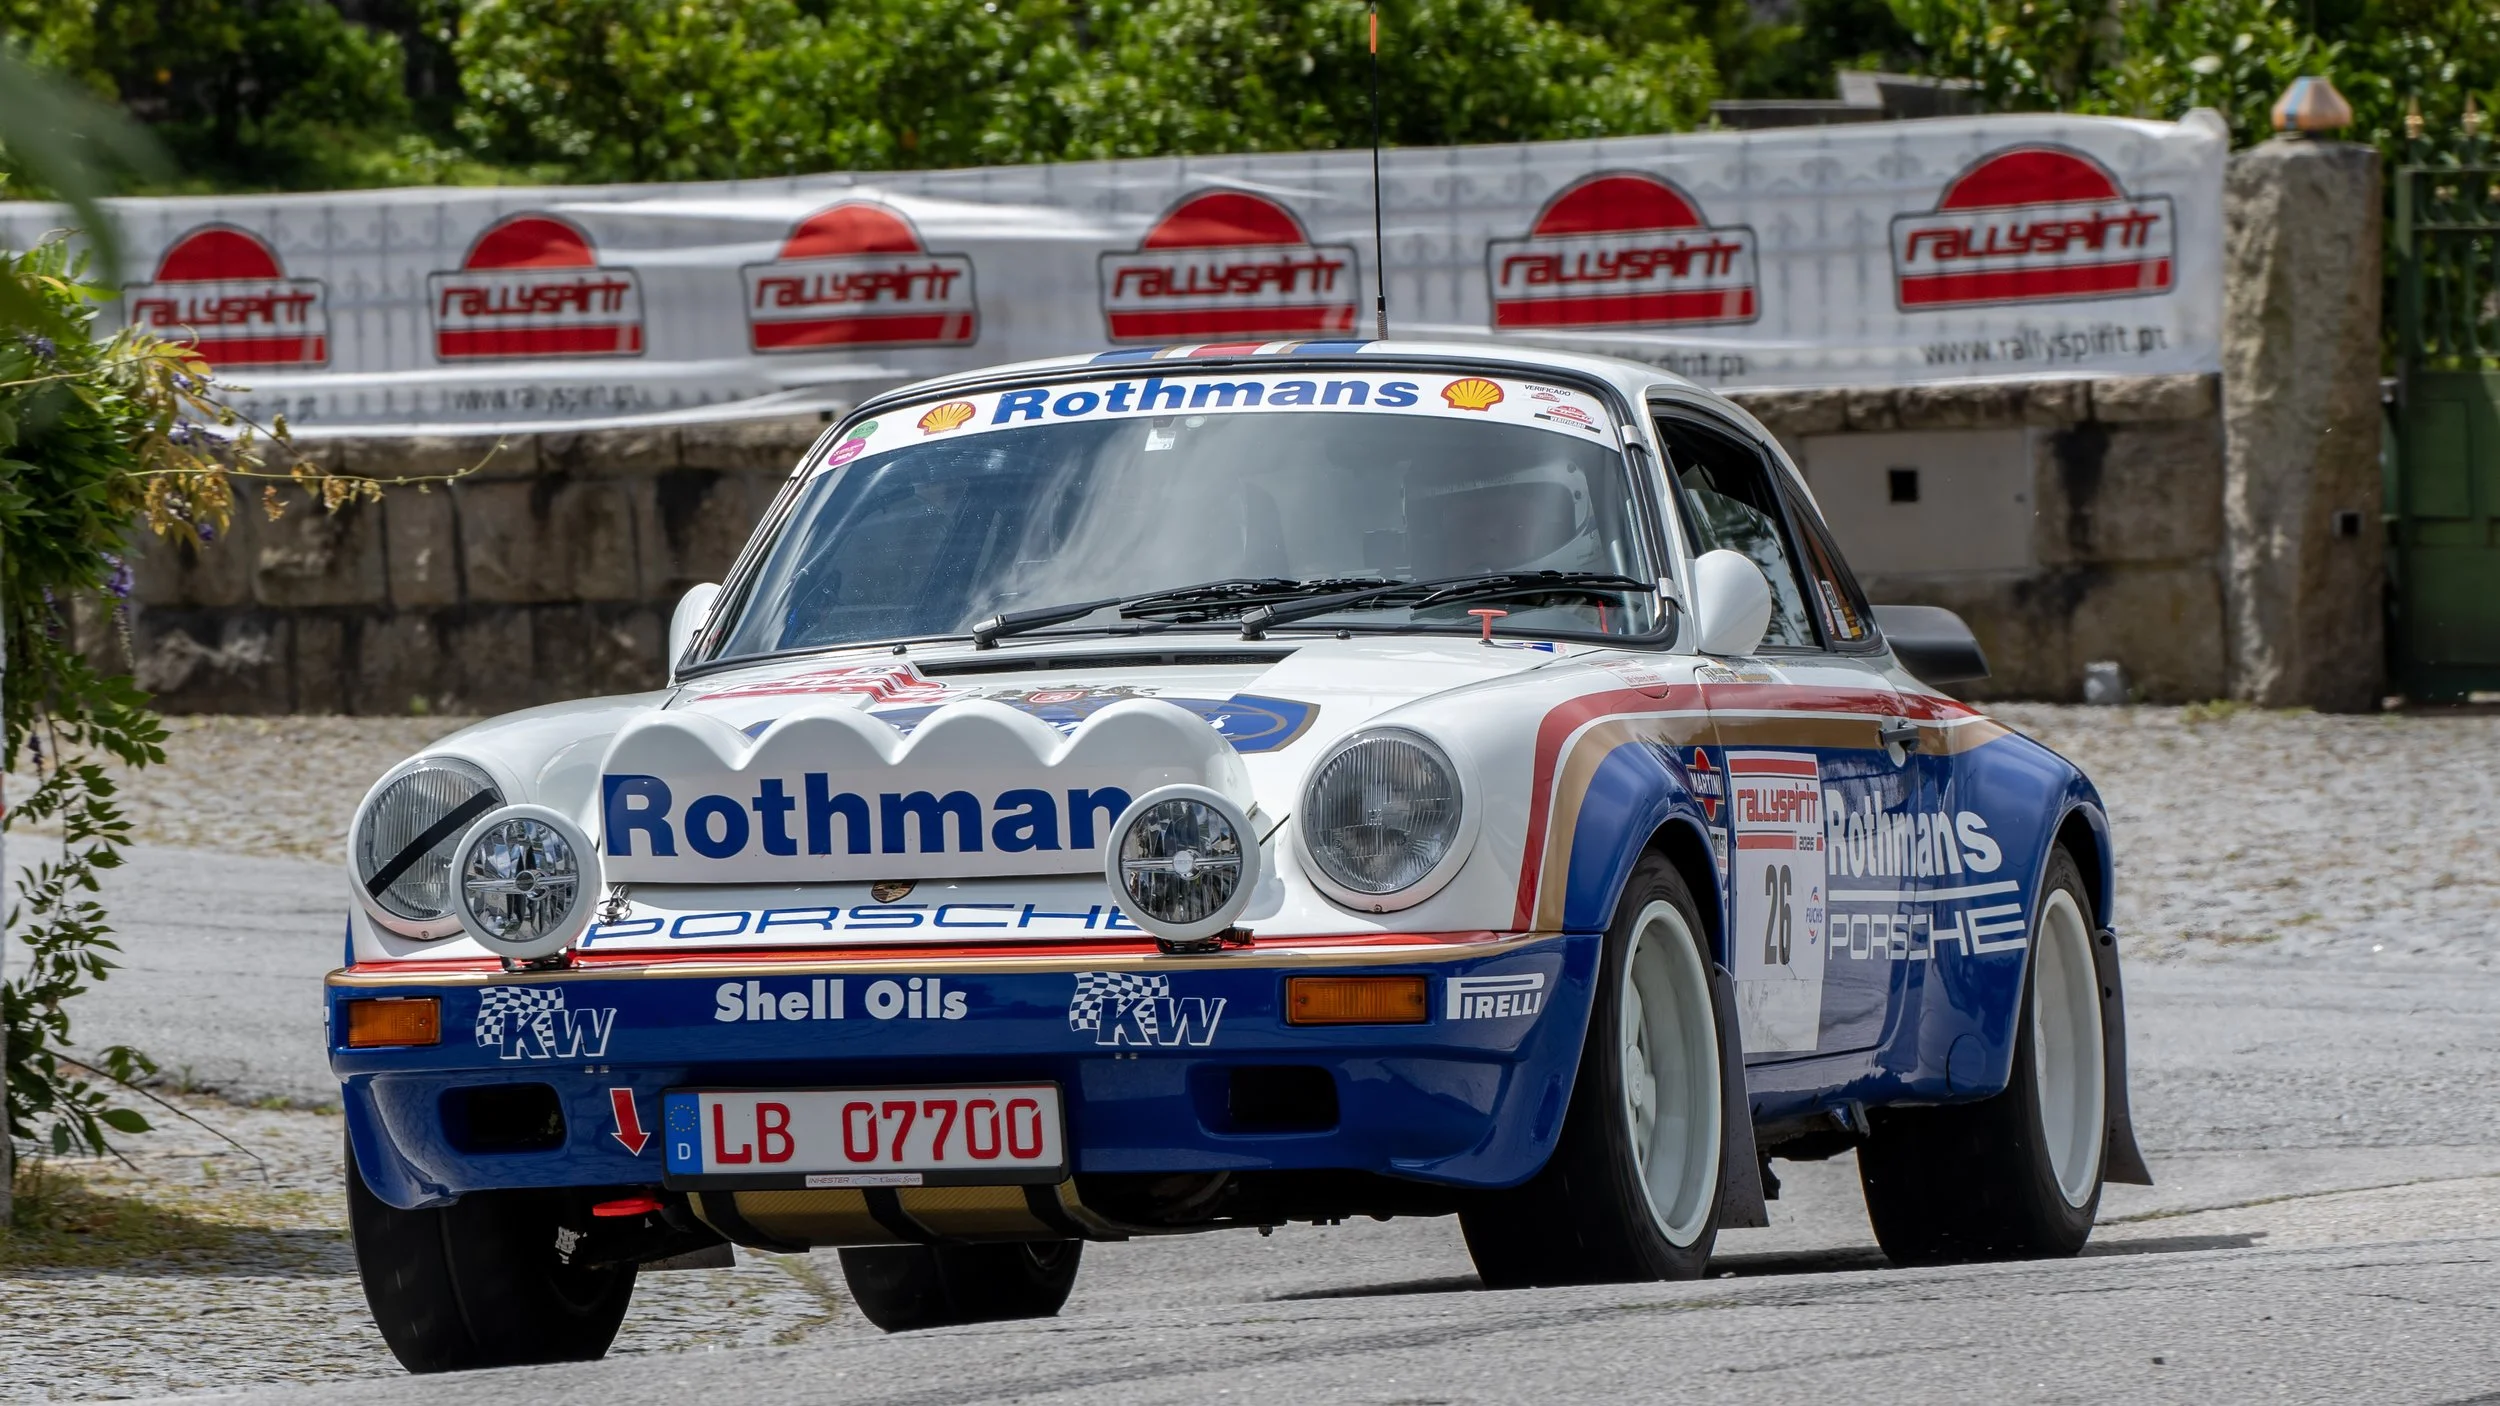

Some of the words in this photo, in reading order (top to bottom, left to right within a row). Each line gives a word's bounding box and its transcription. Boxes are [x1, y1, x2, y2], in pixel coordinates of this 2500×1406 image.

[991, 377, 1419, 425] Rothmans
[1524, 384, 1571, 397] VERIFICADO
[1690, 772, 1722, 796] MARTINI
[1737, 782, 1818, 823] rallyspirit
[1825, 789, 2002, 877] Rothmans
[1765, 864, 1792, 965] 26
[1805, 907, 1823, 924] FUCHS
[1829, 903, 2028, 960] PORSCHE
[714, 978, 844, 1022] Shell
[864, 977, 968, 1021] Oils
[1446, 972, 1545, 1020] PIRELLI
[500, 1007, 618, 1060] KW
[1095, 997, 1228, 1046] KW
[677, 1142, 691, 1160] D
[712, 1102, 795, 1164] LB
[841, 1098, 1044, 1162] 07700
[808, 1176, 850, 1184] INHESTER
